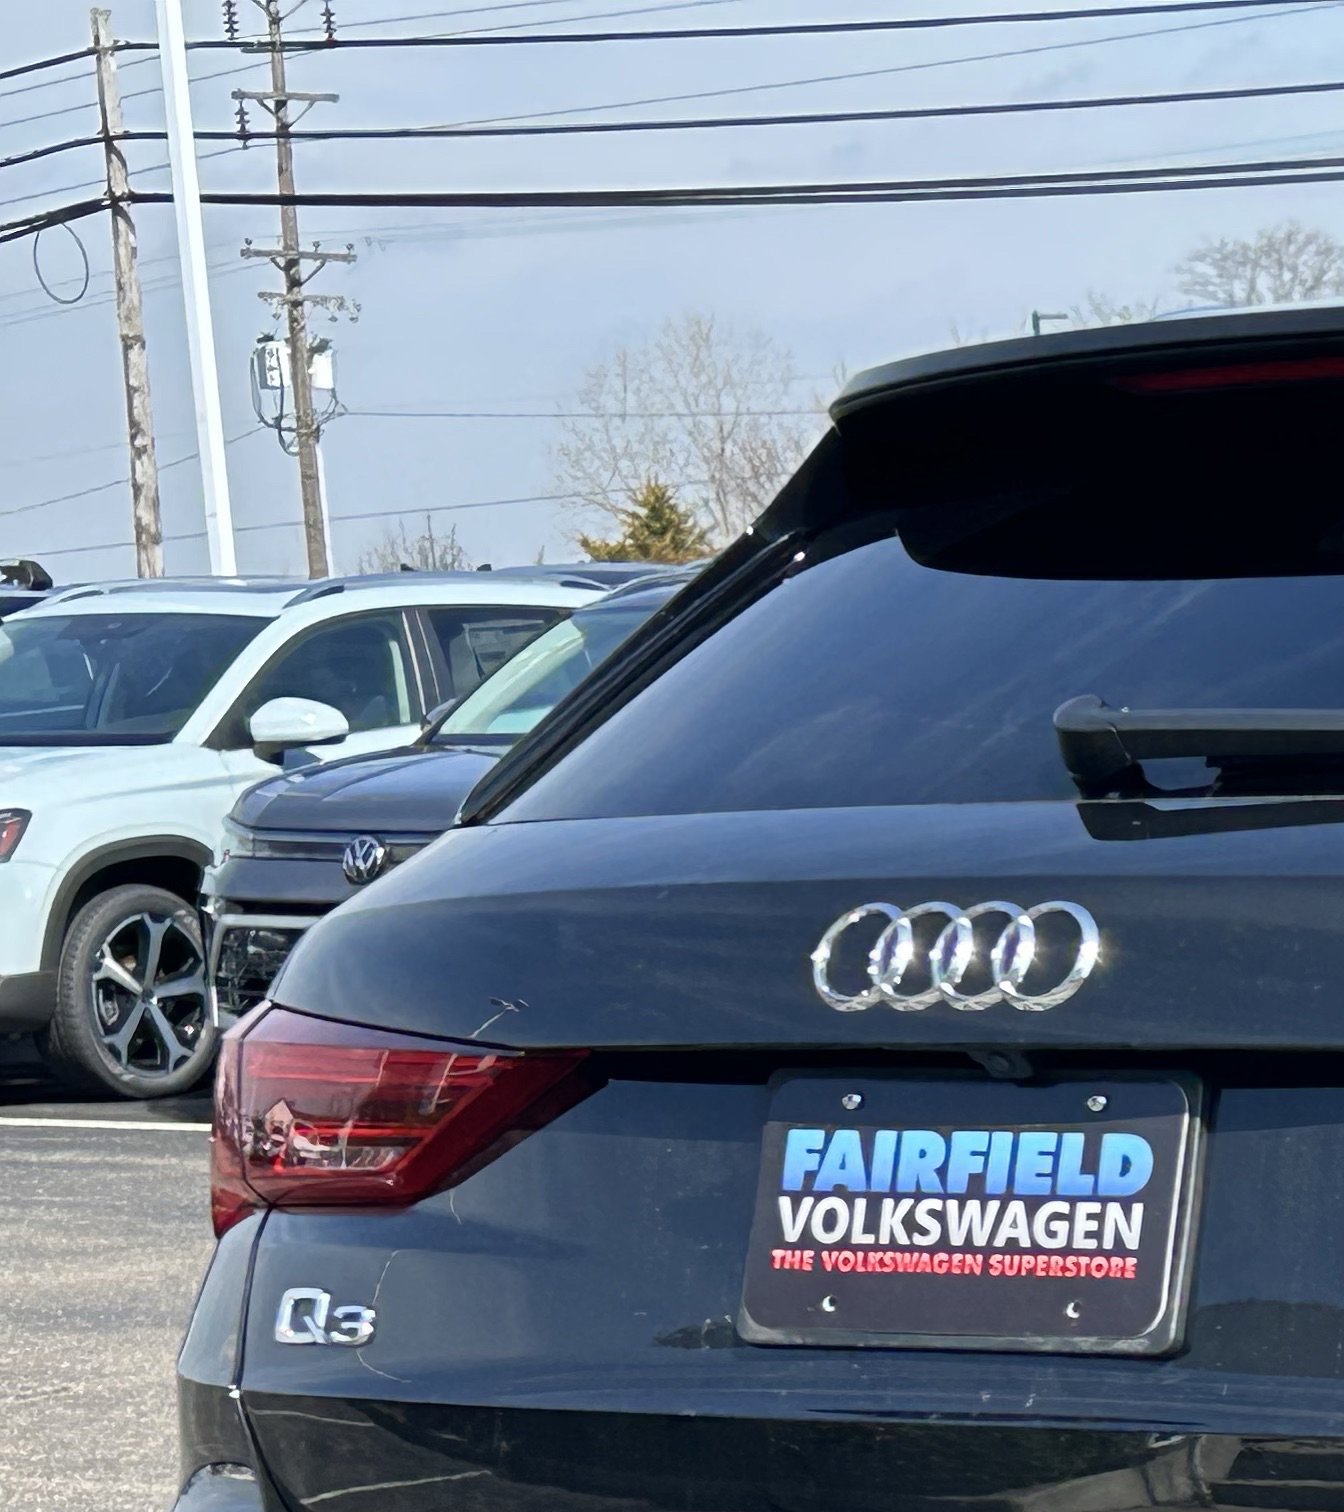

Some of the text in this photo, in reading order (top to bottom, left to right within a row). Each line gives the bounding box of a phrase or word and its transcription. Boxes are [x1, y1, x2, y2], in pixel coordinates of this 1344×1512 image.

[781, 1128, 1155, 1197] FAIRFIELD
[777, 1196, 1144, 1251] VOLKSWAGEN
[770, 1249, 1138, 1280] THE VOLKSWAGEN SUPERSTORE
[274, 1287, 377, 1345] Q3
